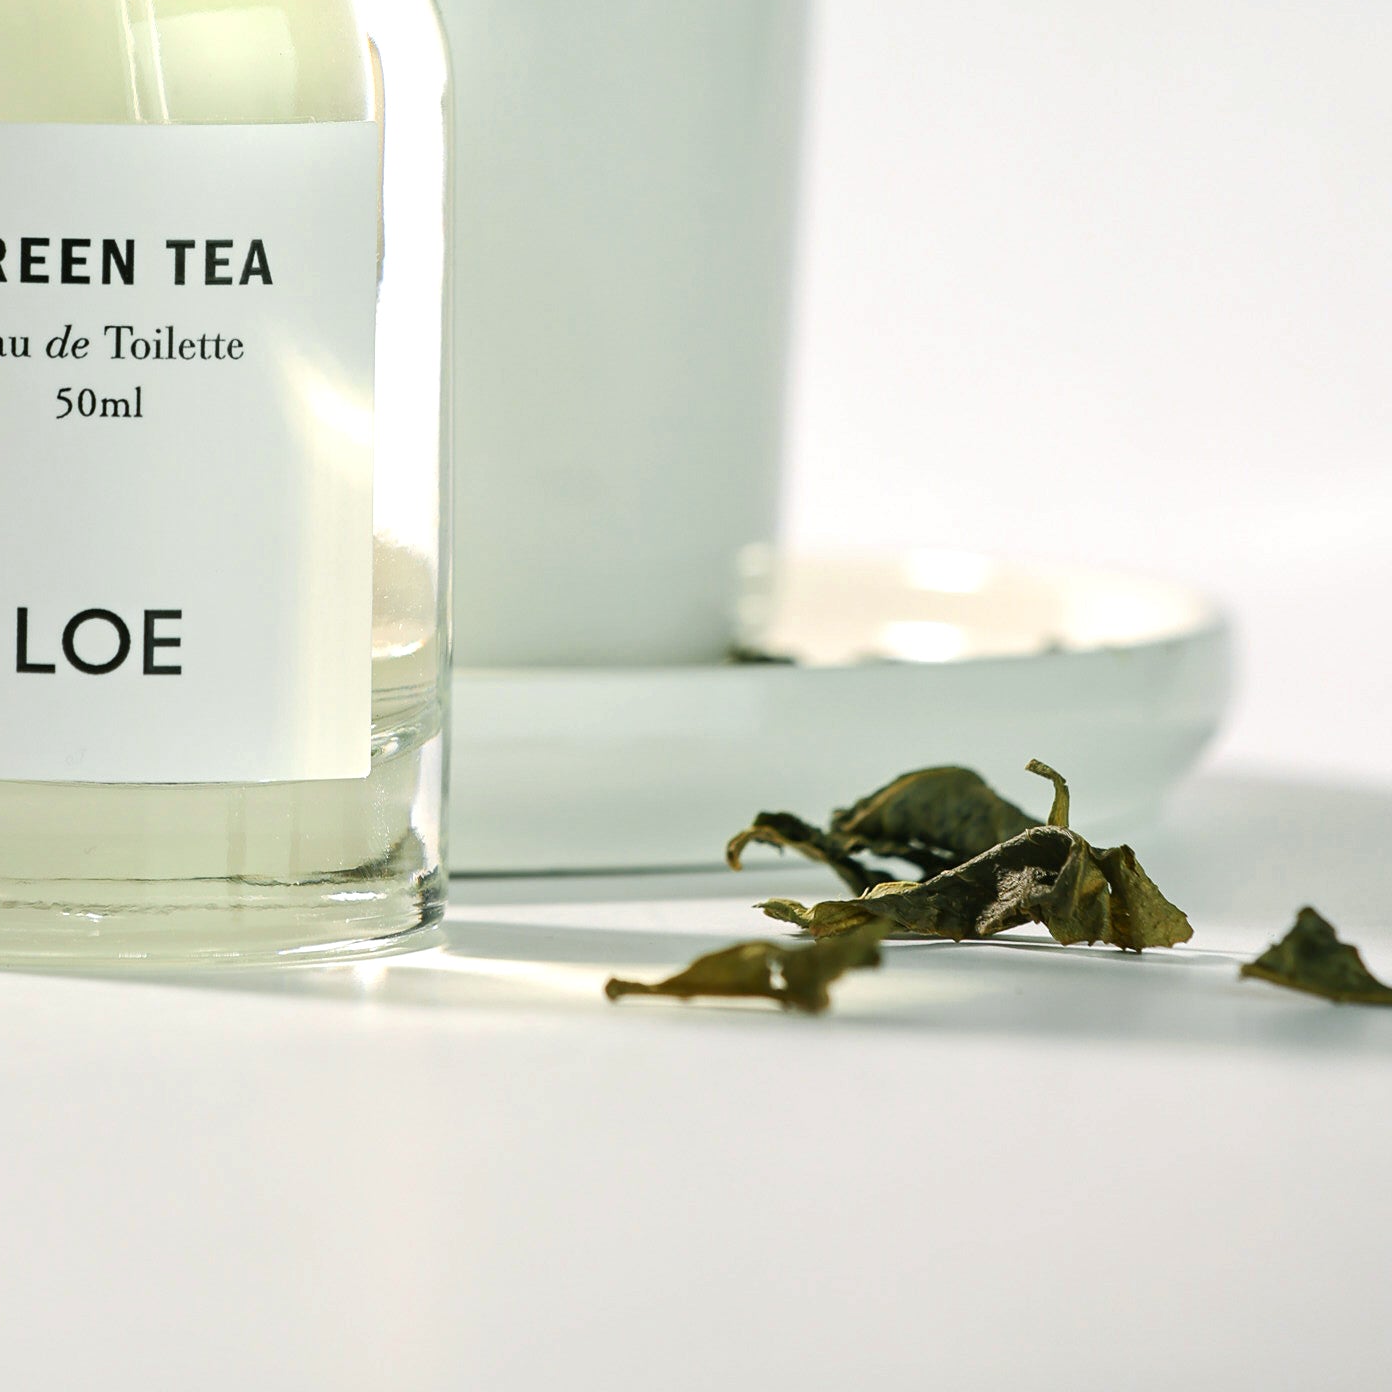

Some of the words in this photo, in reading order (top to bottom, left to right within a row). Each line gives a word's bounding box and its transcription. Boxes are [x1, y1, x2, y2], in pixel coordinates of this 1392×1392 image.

[165, 239, 273, 286] TEA
[45, 324, 90, 360] de
[103, 325, 245, 361] Toilette
[55, 386, 143, 420] 50ml
[15, 606, 183, 676] LOE
